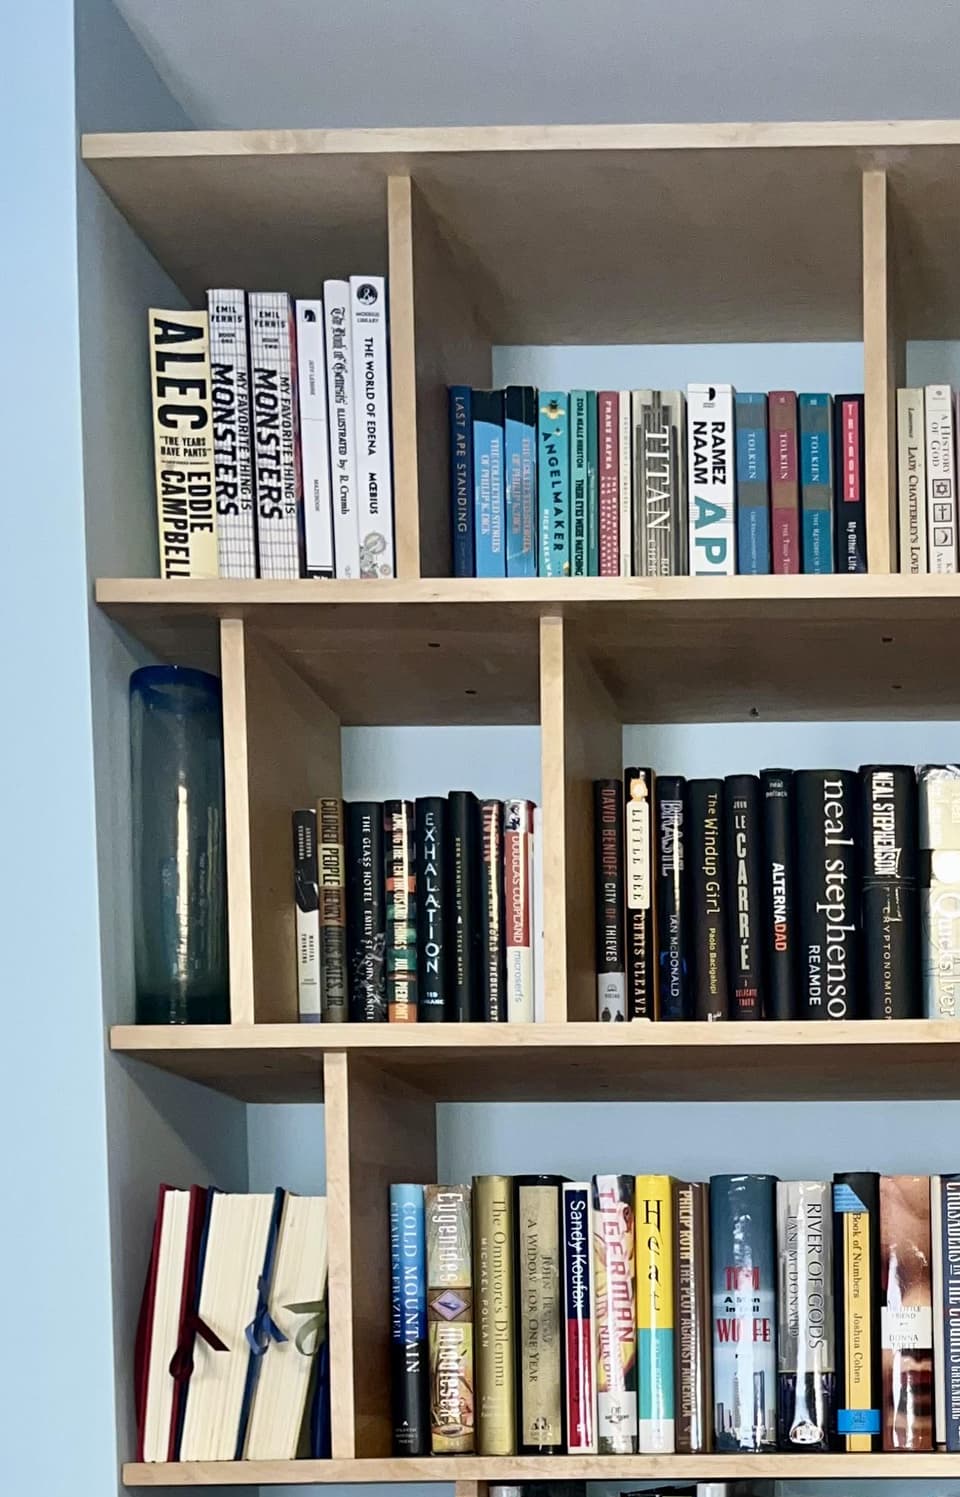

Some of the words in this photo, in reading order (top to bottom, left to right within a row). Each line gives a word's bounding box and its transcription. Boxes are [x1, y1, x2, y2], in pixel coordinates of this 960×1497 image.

[364, 337, 374, 358] THE
[154, 319, 207, 430] ALEC
[236, 371, 247, 388] MY
[365, 361, 375, 400] WORLD
[237, 391, 249, 453] FAVORITE
[366, 403, 376, 418] OF
[455, 397, 466, 426] LAST
[211, 363, 239, 516] MONSTERS
[367, 421, 376, 456] EDENA
[456, 433, 466, 456] APE
[693, 421, 707, 485] NAAM
[711, 421, 726, 485] RAMEZ
[747, 432, 756, 479] TOLKIEN
[188, 471, 212, 532] EDDIE
[240, 458, 250, 495] THING
[457, 464, 467, 533] STANDING
[542, 432, 565, 551] ANGELMAKER
[645, 425, 671, 532] TITAN
[161, 470, 190, 579] CAMPBELL
[242, 499, 251, 510] IS
[708, 794, 718, 815] The
[872, 772, 894, 800] NEAL
[824, 780, 853, 847] neal
[873, 803, 896, 875] STEPHENSON
[363, 837, 371, 867] GLASS
[702, 818, 718, 875] Windup
[363, 871, 371, 902] HOTEL
[424, 813, 441, 973] EXHALATION
[706, 881, 720, 914] Girl
[772, 863, 786, 951] ALTERNADAD
[816, 859, 855, 1020] stephenso
[809, 945, 820, 1006] REAMDE
[404, 1201, 417, 1256] COLD
[492, 1199, 506, 1226] The
[852, 1213, 861, 1237] Book
[853, 1241, 862, 1250] of
[492, 1231, 508, 1314] Omnivore's
[853, 1252, 863, 1298] Numbers
[405, 1265, 420, 1373] MOUNTAIN
[853, 1313, 863, 1349] Joshua
[494, 1320, 508, 1387] Dilemma
[854, 1352, 863, 1383] Cohen
